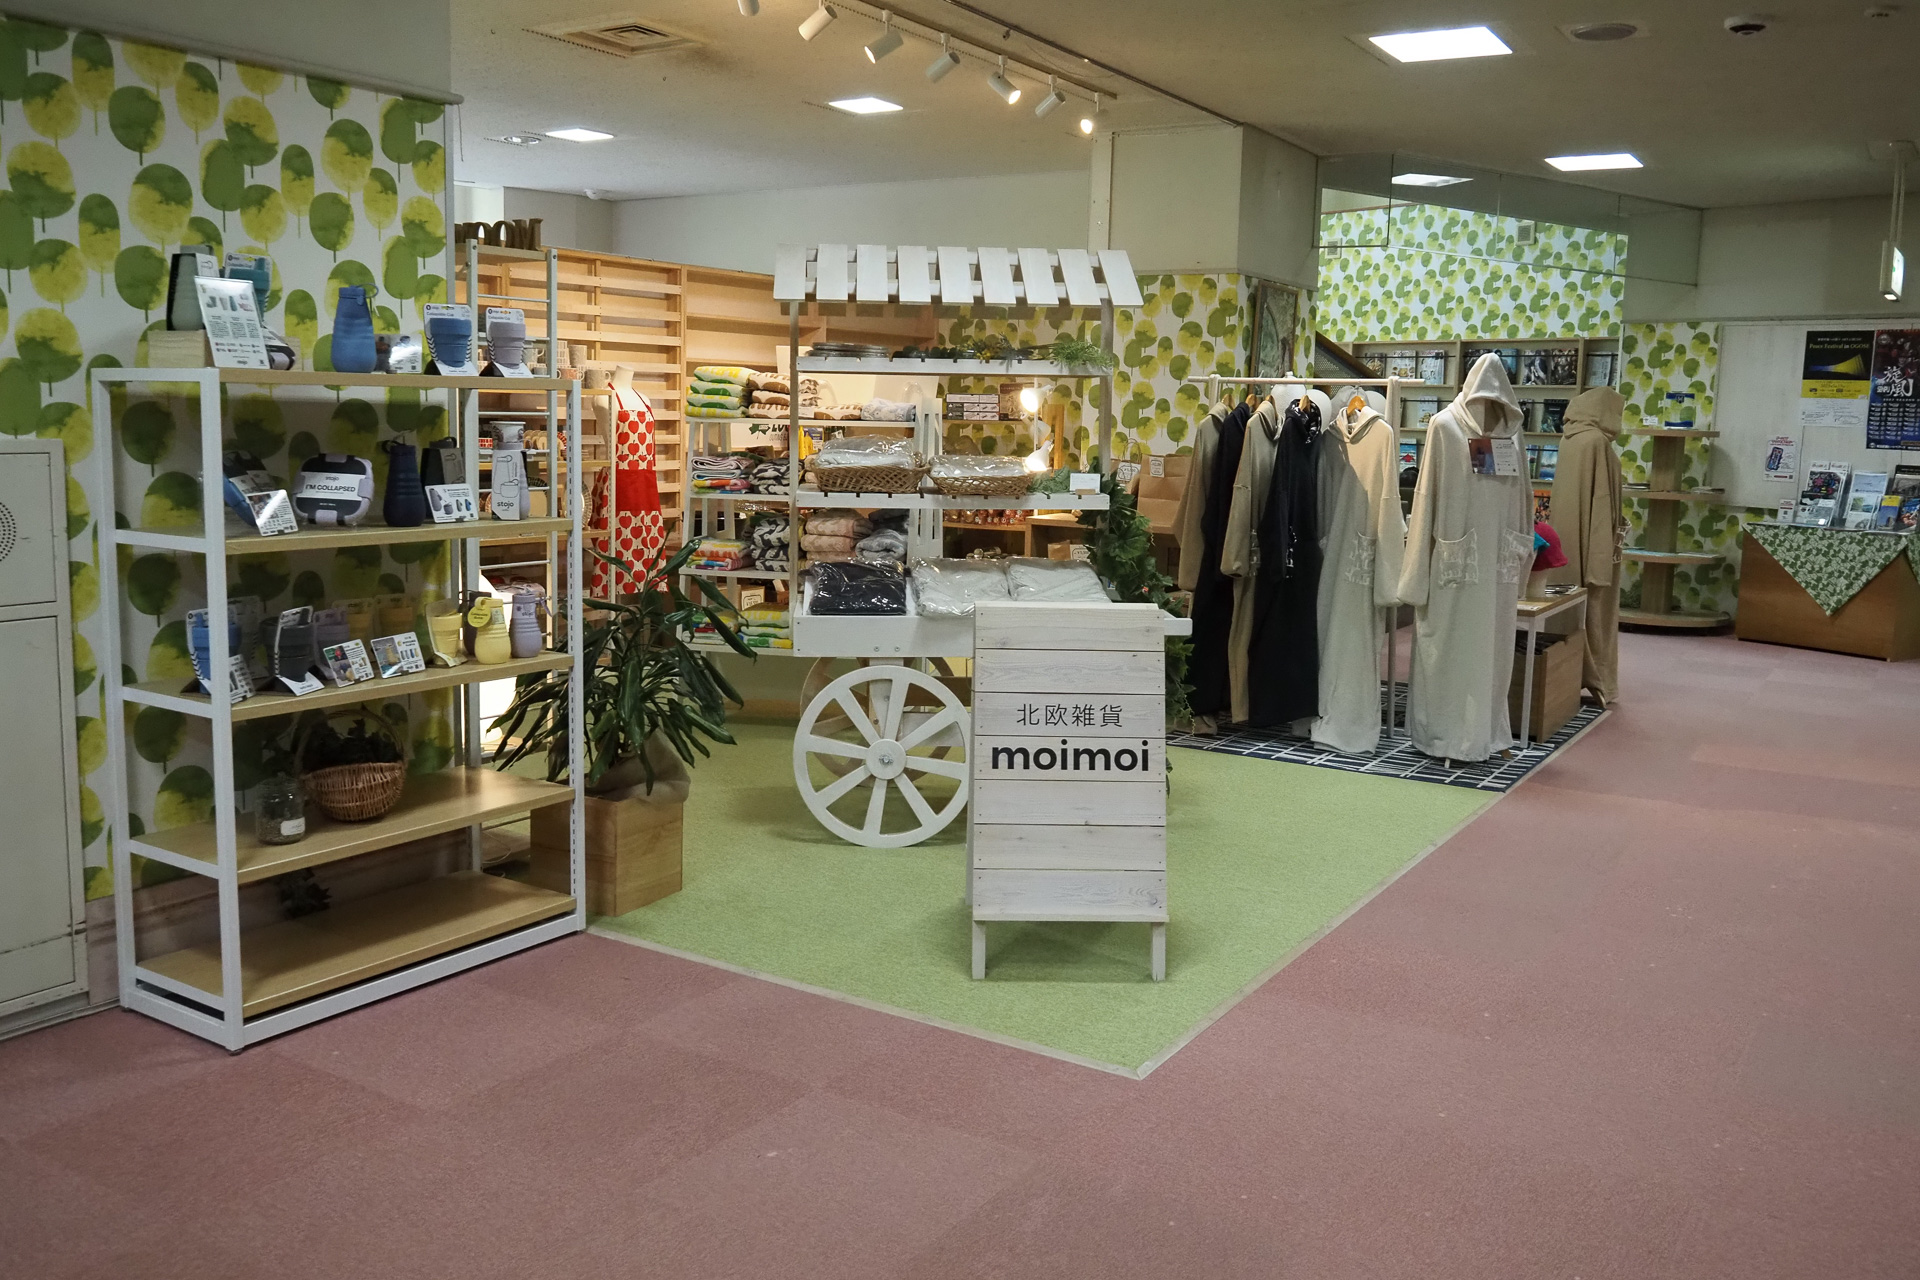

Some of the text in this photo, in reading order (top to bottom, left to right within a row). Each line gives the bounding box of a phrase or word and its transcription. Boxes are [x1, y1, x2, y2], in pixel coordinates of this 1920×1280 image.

[497, 501, 514, 510] stojo
[1016, 703, 1123, 728] 北欧雑貨
[991, 738, 1150, 772] moimoi
